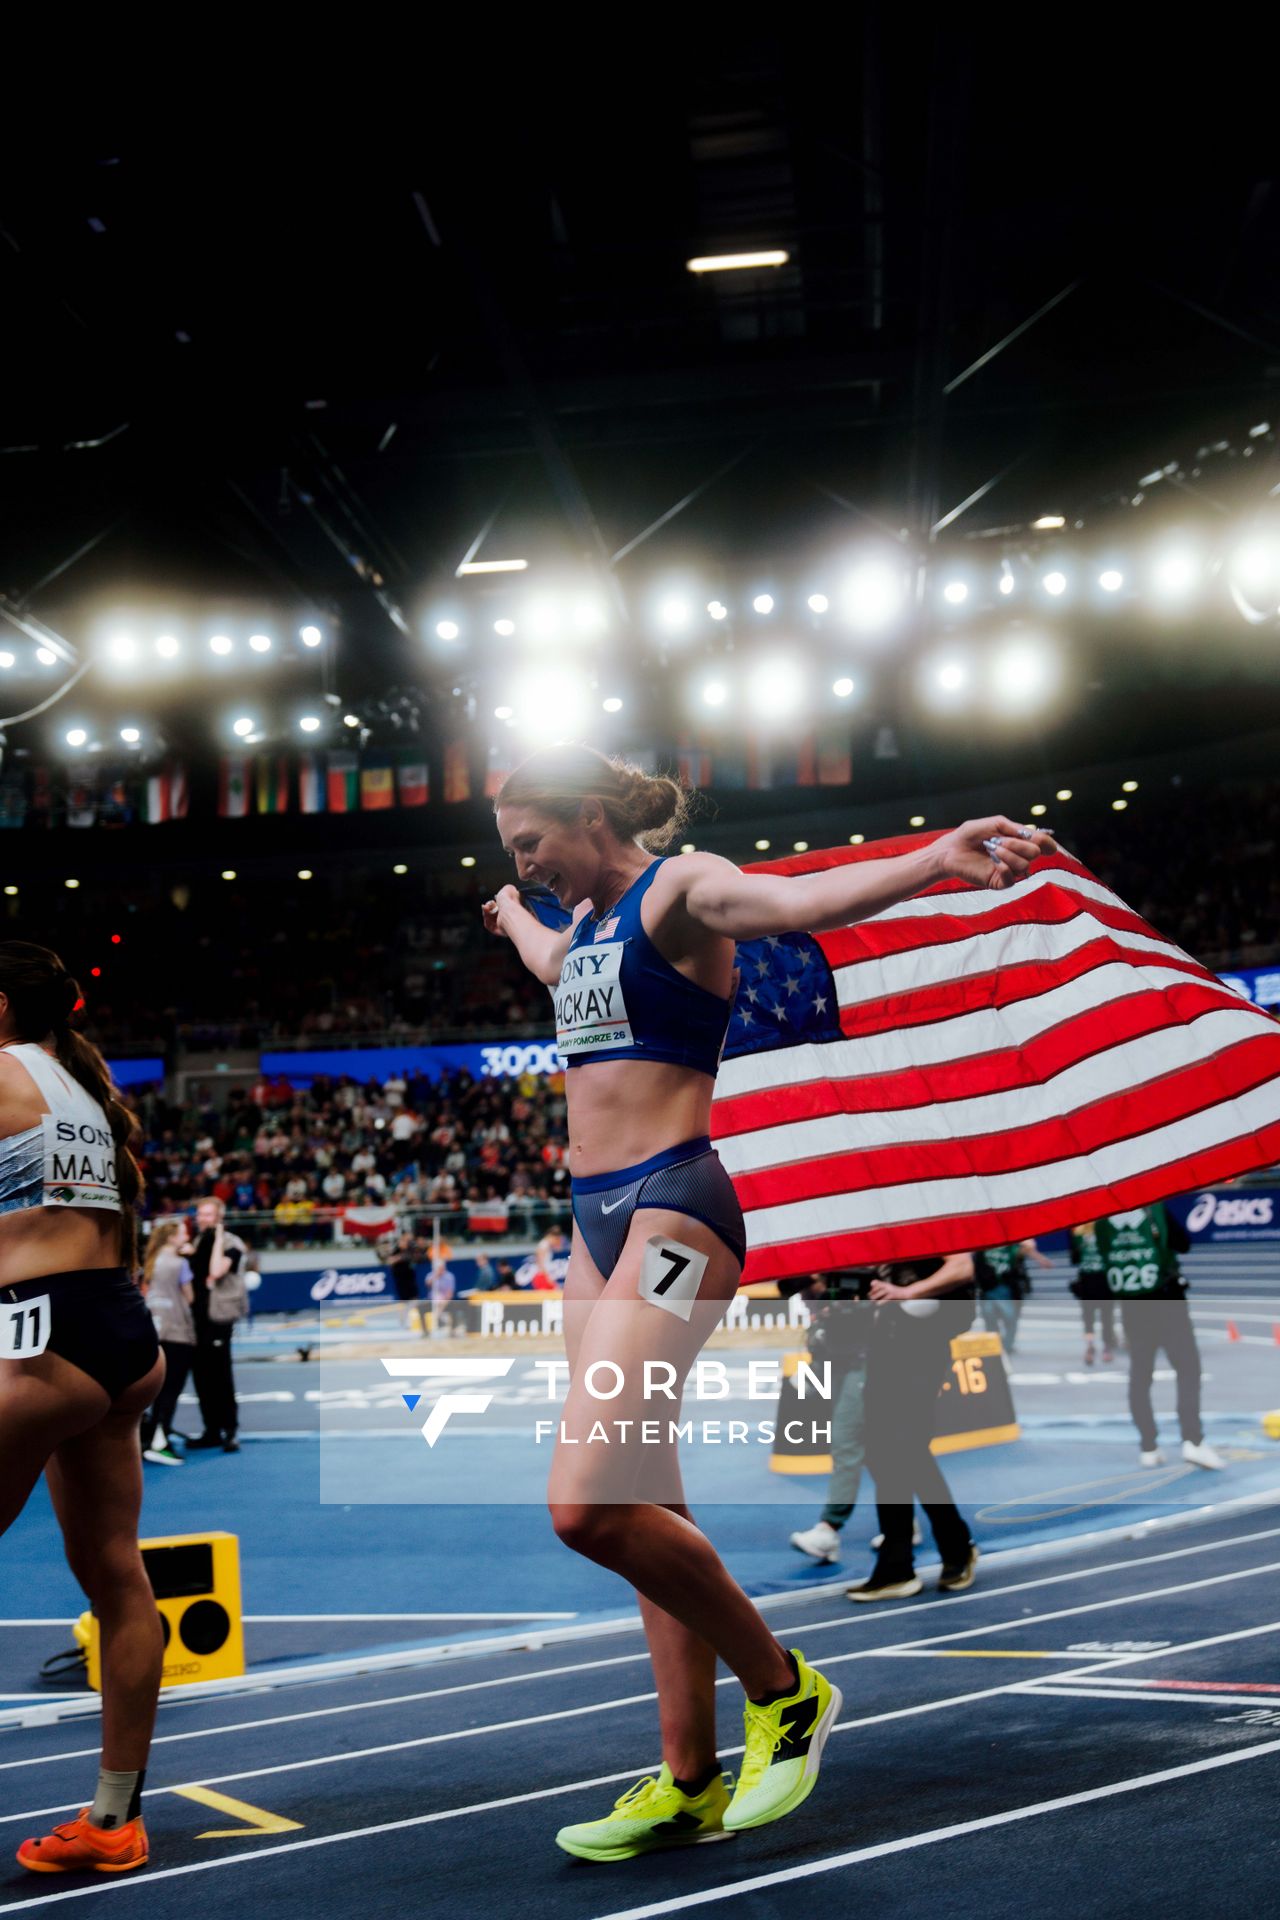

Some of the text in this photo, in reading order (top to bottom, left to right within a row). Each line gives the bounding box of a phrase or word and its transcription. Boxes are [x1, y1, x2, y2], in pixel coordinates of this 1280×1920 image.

[562, 953, 610, 984] ONY
[555, 986, 614, 1026] ACKAY
[573, 1032, 612, 1046] POMORZE
[613, 1030, 626, 1041] 26
[56, 1122, 112, 1148] SON
[53, 1153, 118, 1186] MAJO
[653, 1248, 691, 1296] 7
[1107, 1263, 1160, 1293] 026
[9, 1306, 41, 1350] 11
[162, 1661, 202, 1677] EIKO
